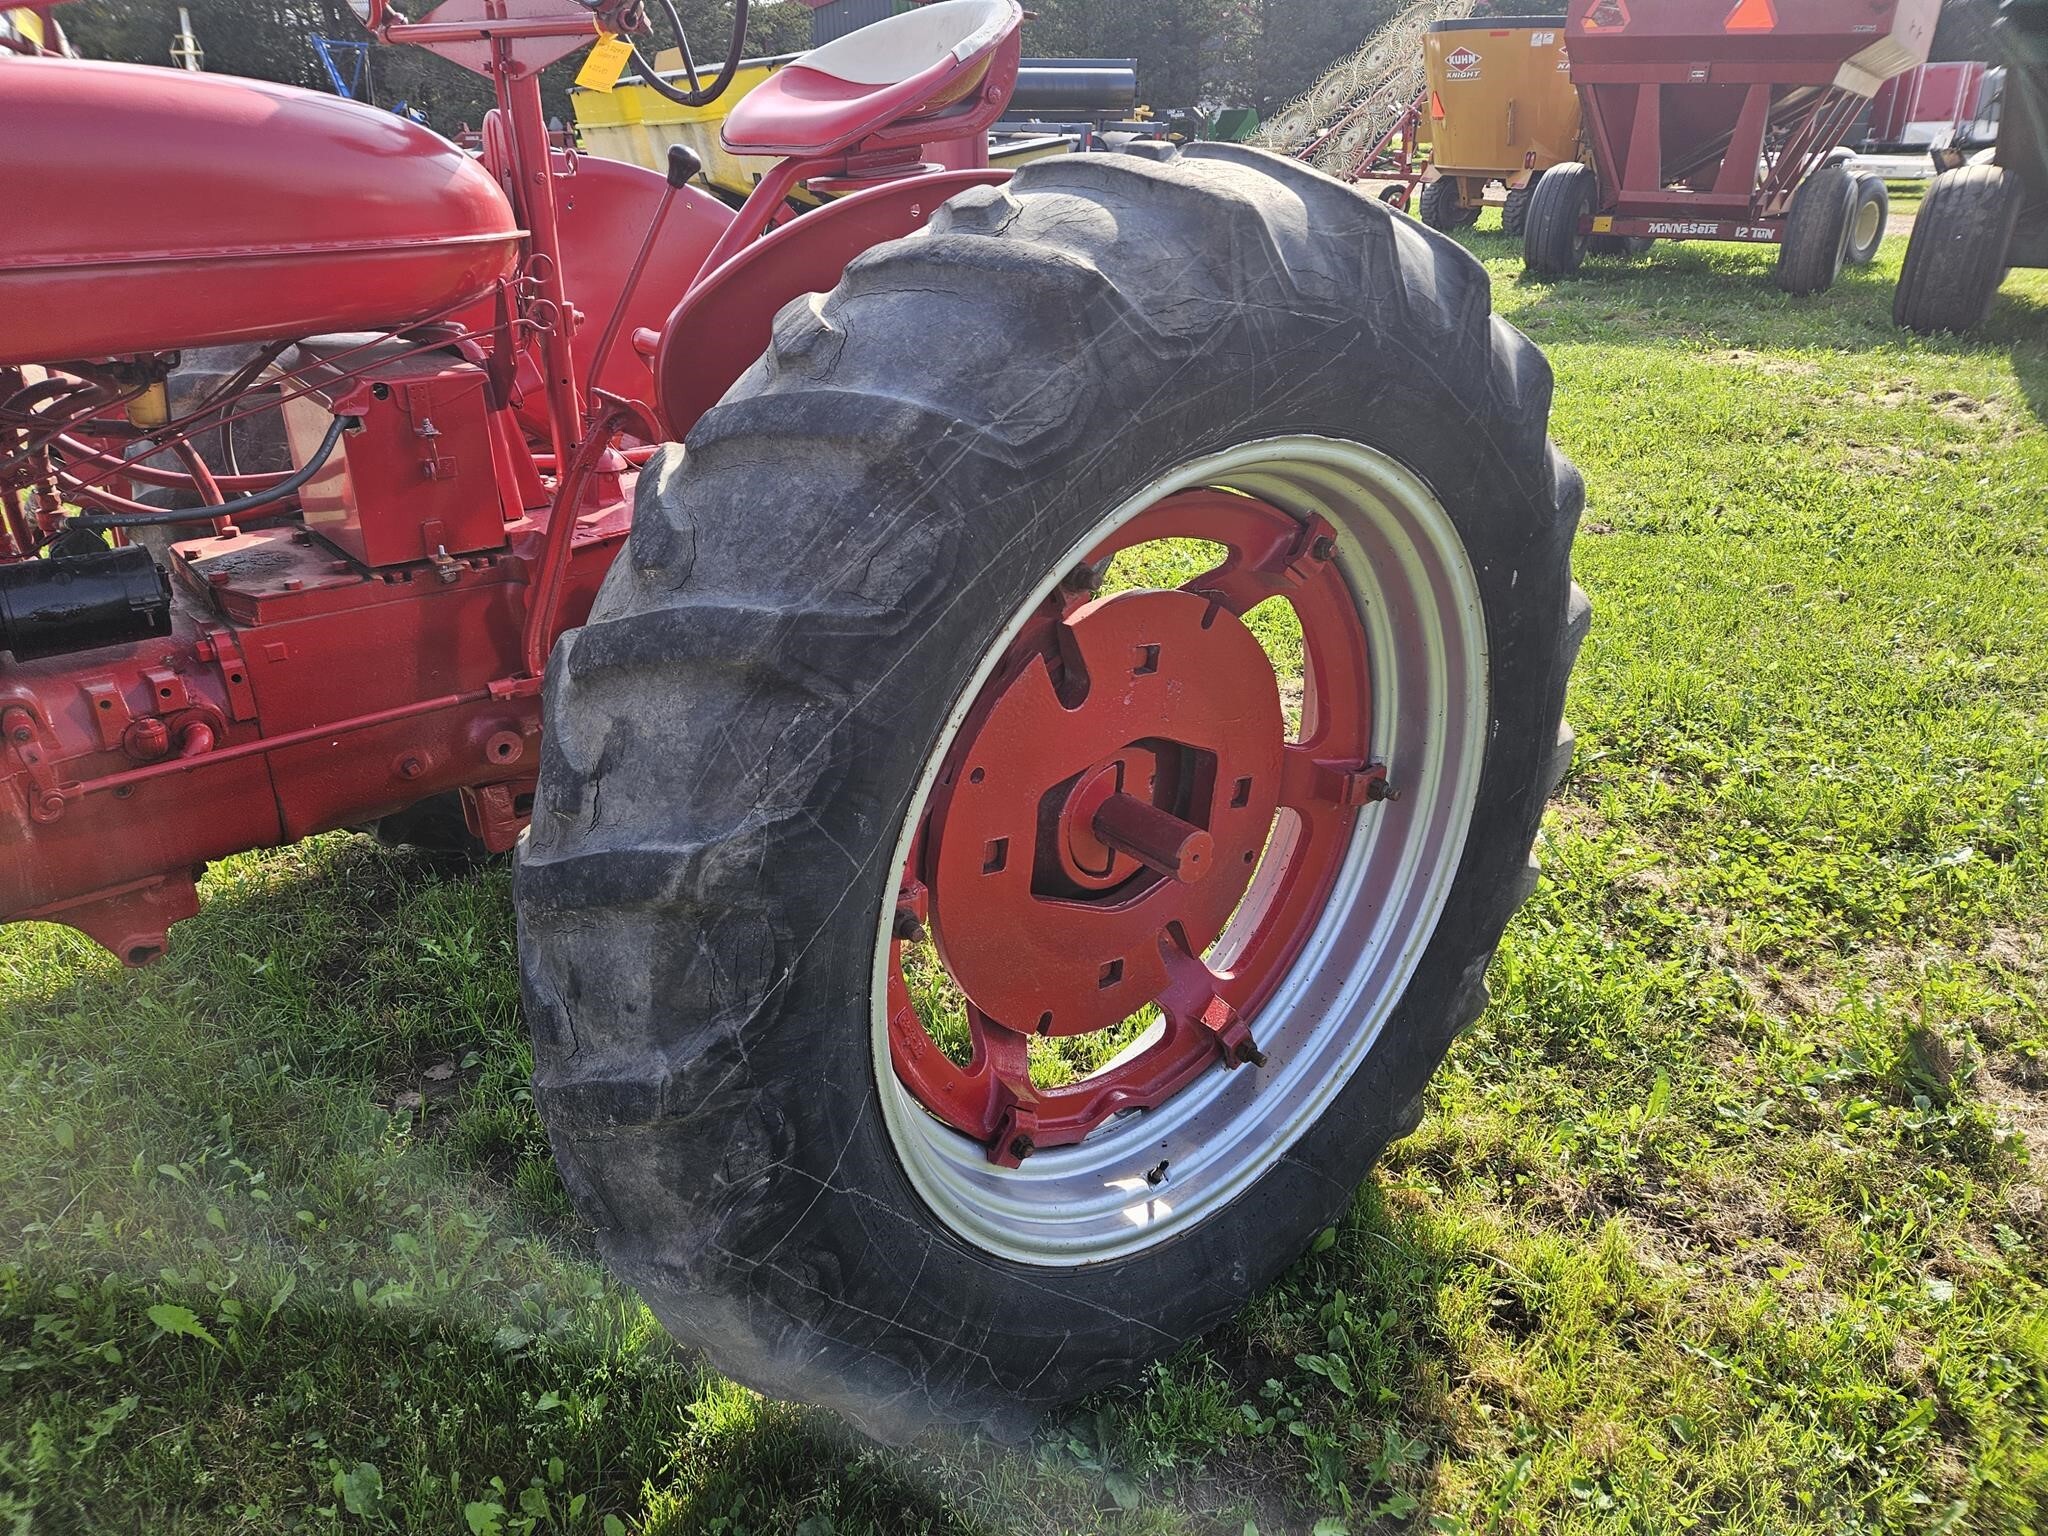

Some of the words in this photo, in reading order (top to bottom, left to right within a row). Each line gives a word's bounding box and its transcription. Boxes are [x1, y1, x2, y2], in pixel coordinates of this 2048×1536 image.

[1448, 53, 1475, 65] KUHN
[1446, 70, 1480, 79] KNIGHT
[1735, 226, 1749, 237] 12
[1751, 227, 1775, 239] TON
